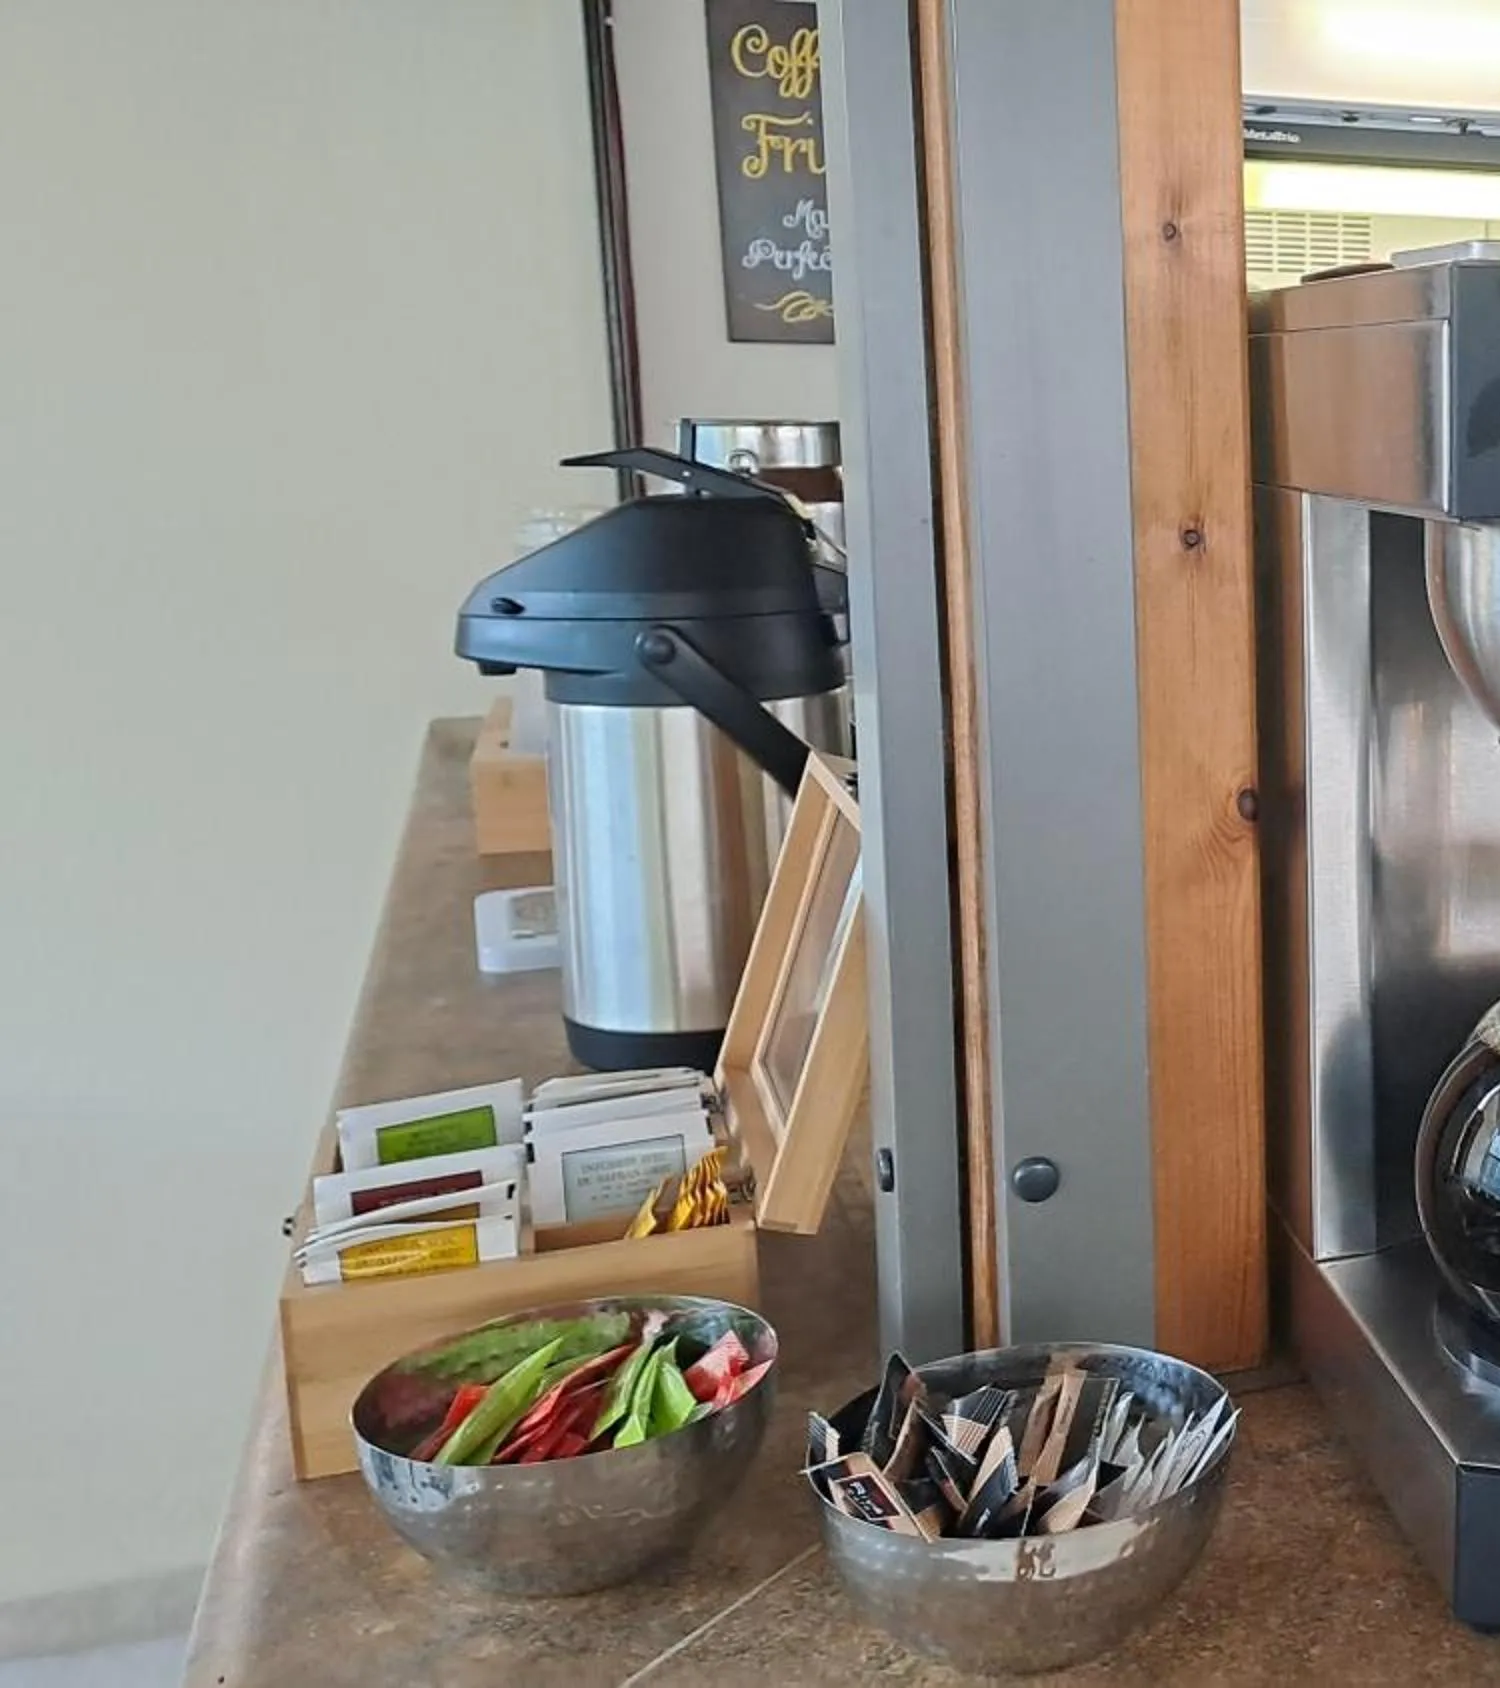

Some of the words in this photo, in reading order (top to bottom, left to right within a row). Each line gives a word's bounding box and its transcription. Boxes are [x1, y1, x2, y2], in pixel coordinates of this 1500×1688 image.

[731, 23, 820, 98] Coff
[741, 111, 826, 178] Fri
[782, 199, 830, 239] Ma
